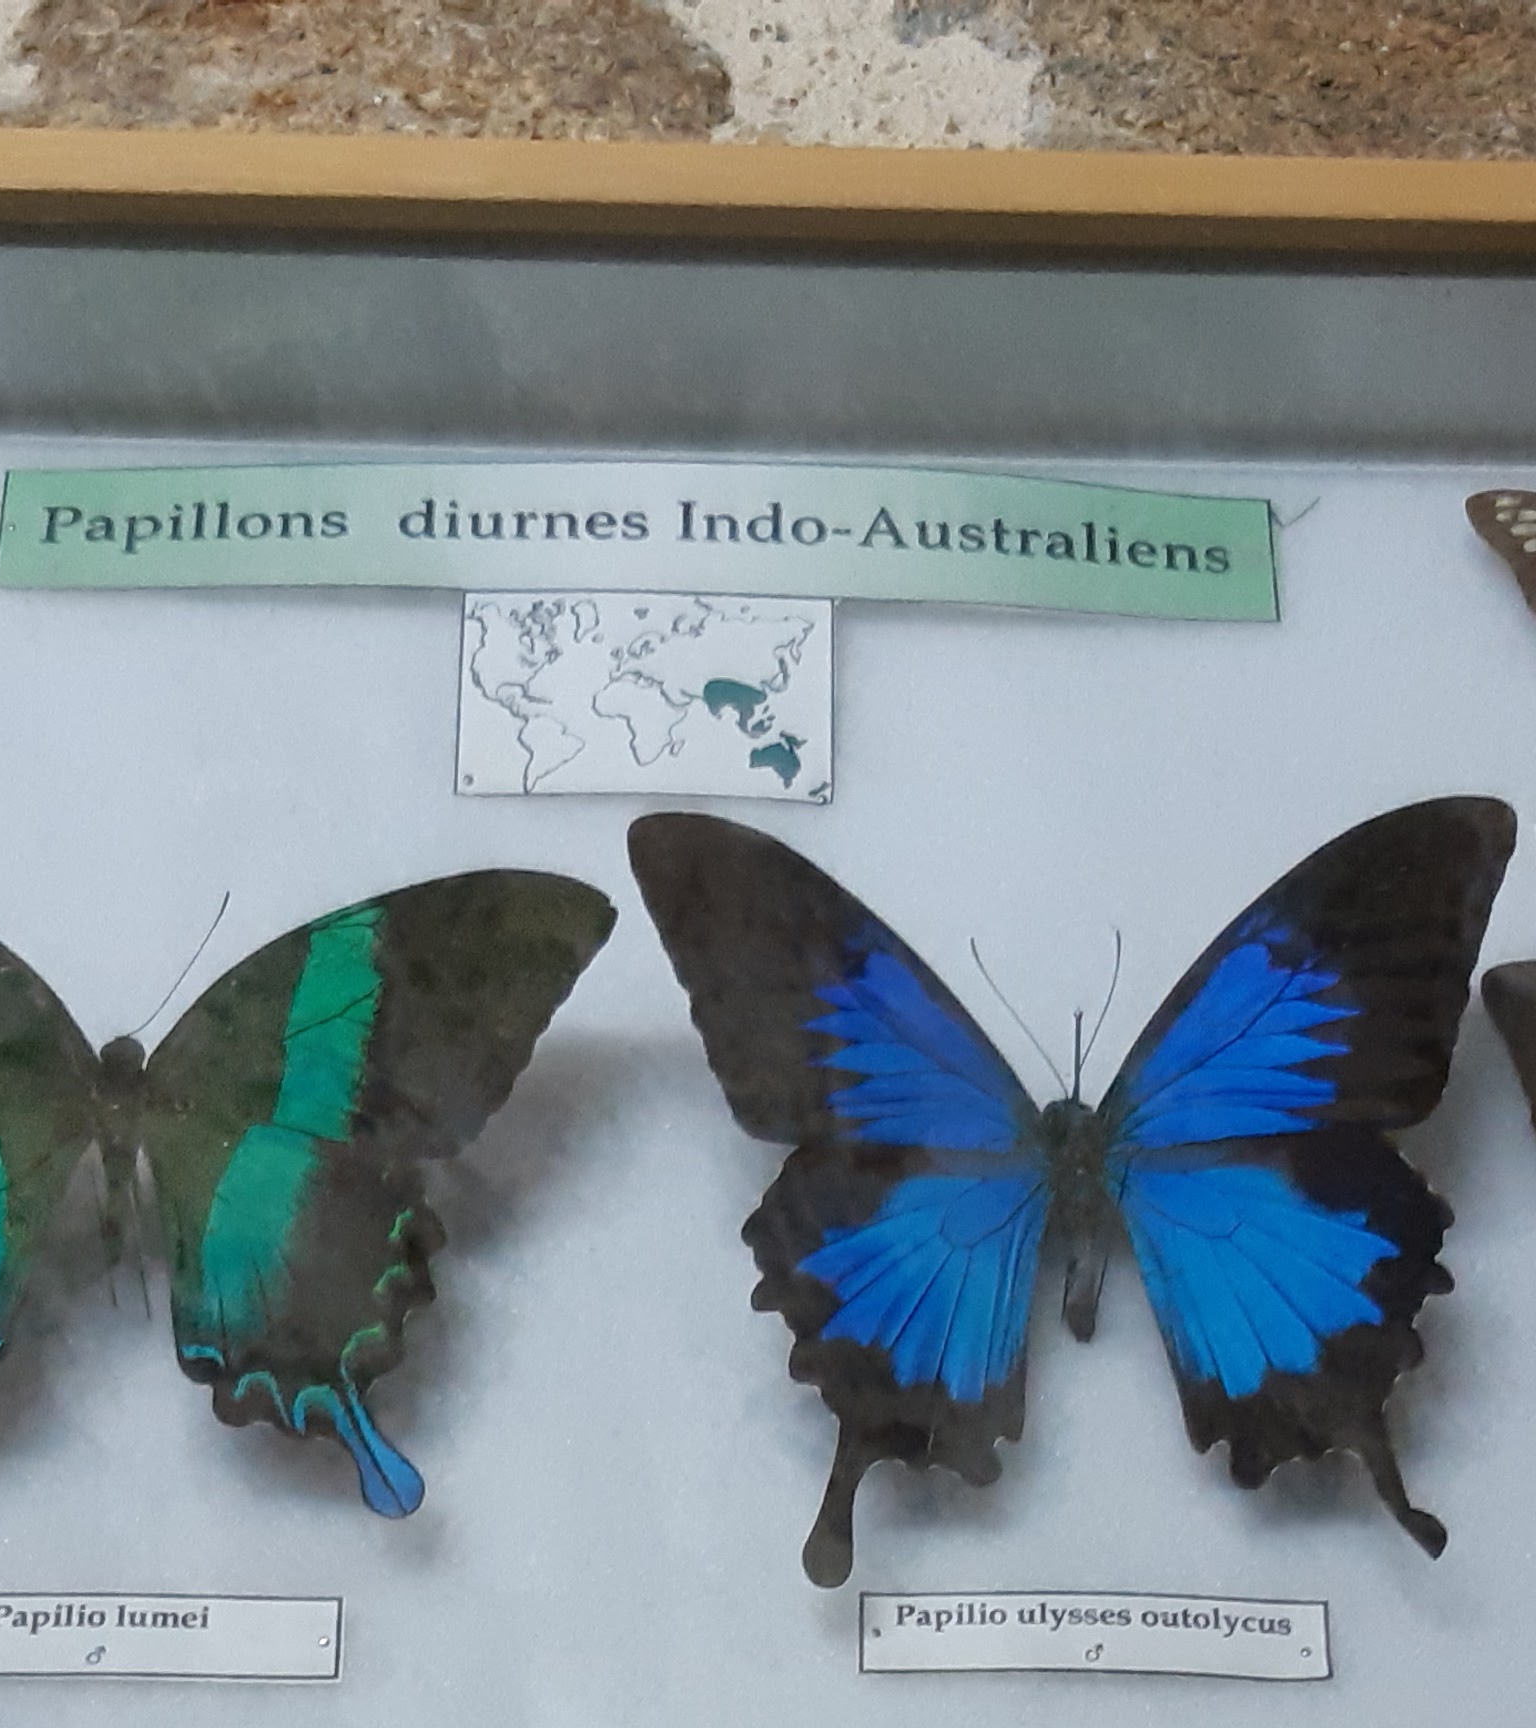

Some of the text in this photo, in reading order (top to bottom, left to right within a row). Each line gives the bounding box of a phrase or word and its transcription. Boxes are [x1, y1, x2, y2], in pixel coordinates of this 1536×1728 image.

[39, 497, 1232, 576] Papillons diurnes Indo-Australiens
[116, 1605, 210, 1629] lumei
[896, 1603, 1292, 1638] Papilio ulysses outolycus
